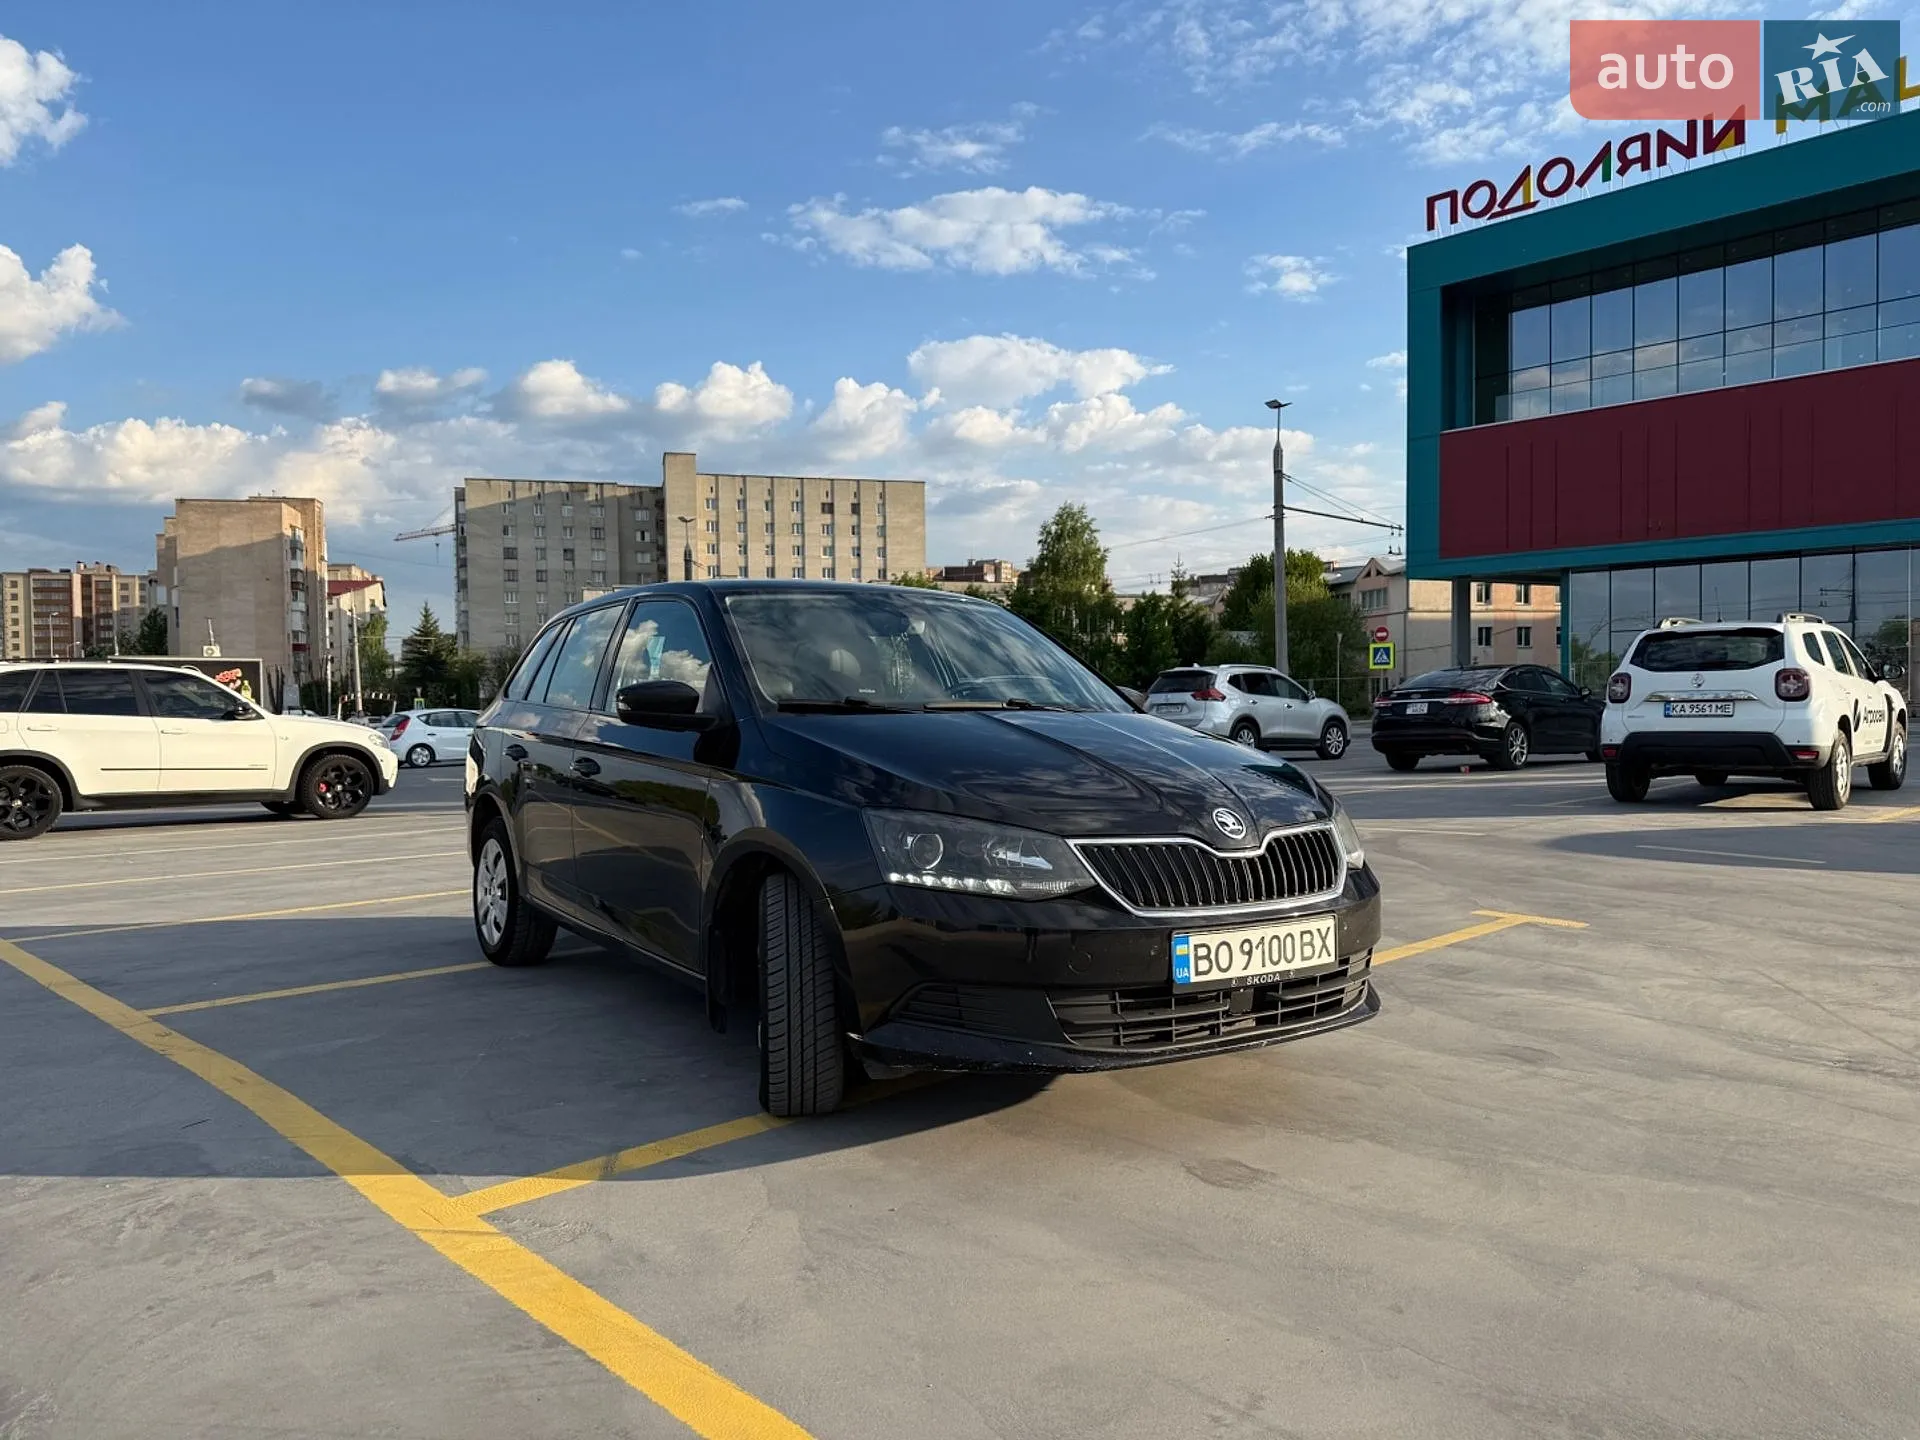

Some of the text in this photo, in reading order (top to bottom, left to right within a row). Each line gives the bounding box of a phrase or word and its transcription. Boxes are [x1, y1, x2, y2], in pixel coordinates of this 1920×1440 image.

[1671, 703, 1687, 714] KA
[1715, 703, 1732, 714] ME
[1193, 926, 1332, 977] BO 9100 BX
[1175, 967, 1190, 979] UA
[1246, 972, 1281, 986] SKODA
